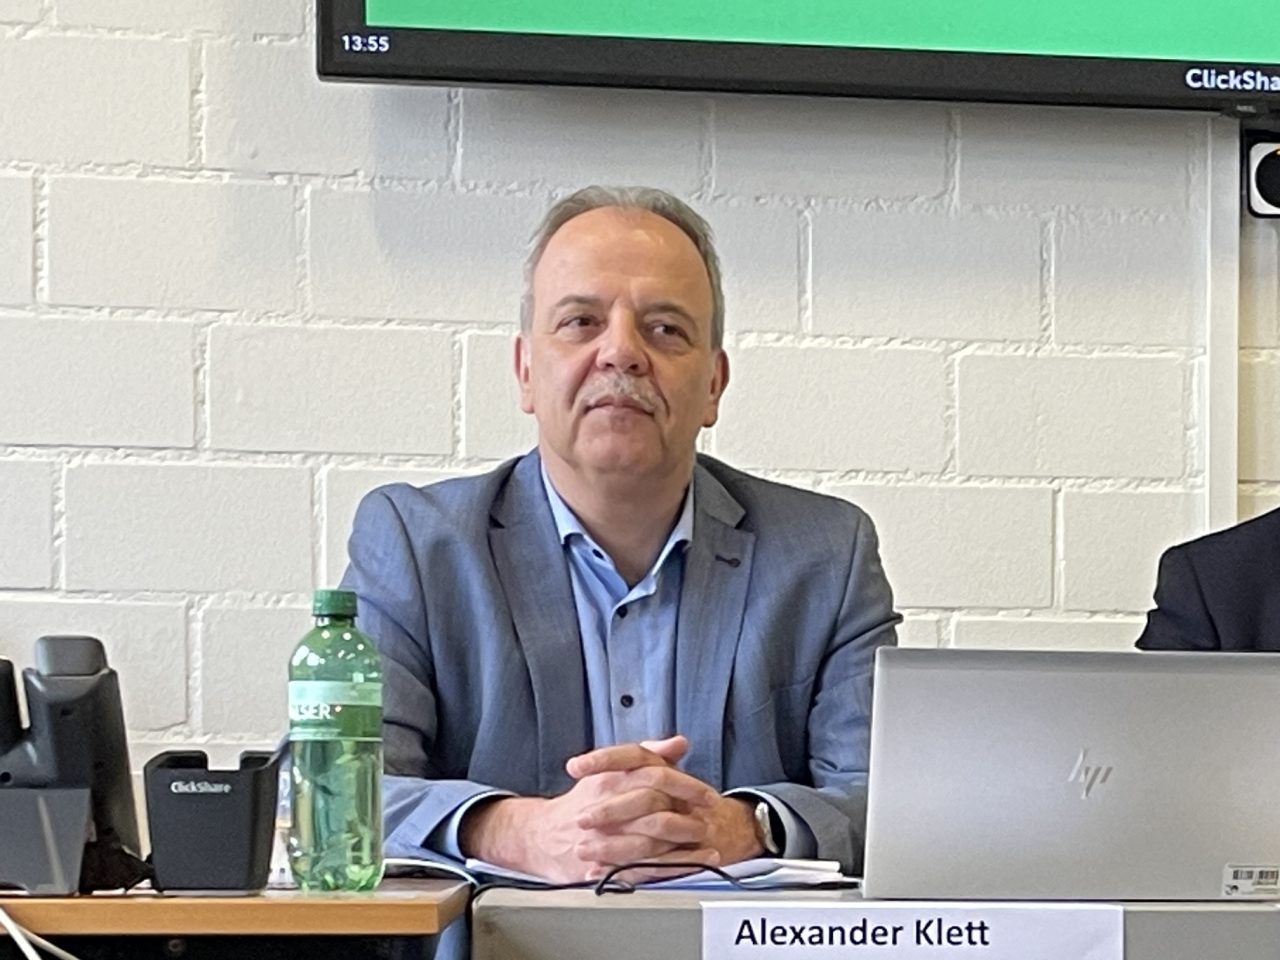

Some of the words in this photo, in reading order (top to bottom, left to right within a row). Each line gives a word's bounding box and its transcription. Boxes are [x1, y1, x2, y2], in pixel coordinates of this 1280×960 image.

[341, 34, 390, 52] 13:55
[170, 780, 232, 793] ClickShare
[734, 917, 904, 946] Alexander
[915, 917, 990, 946] Klett
